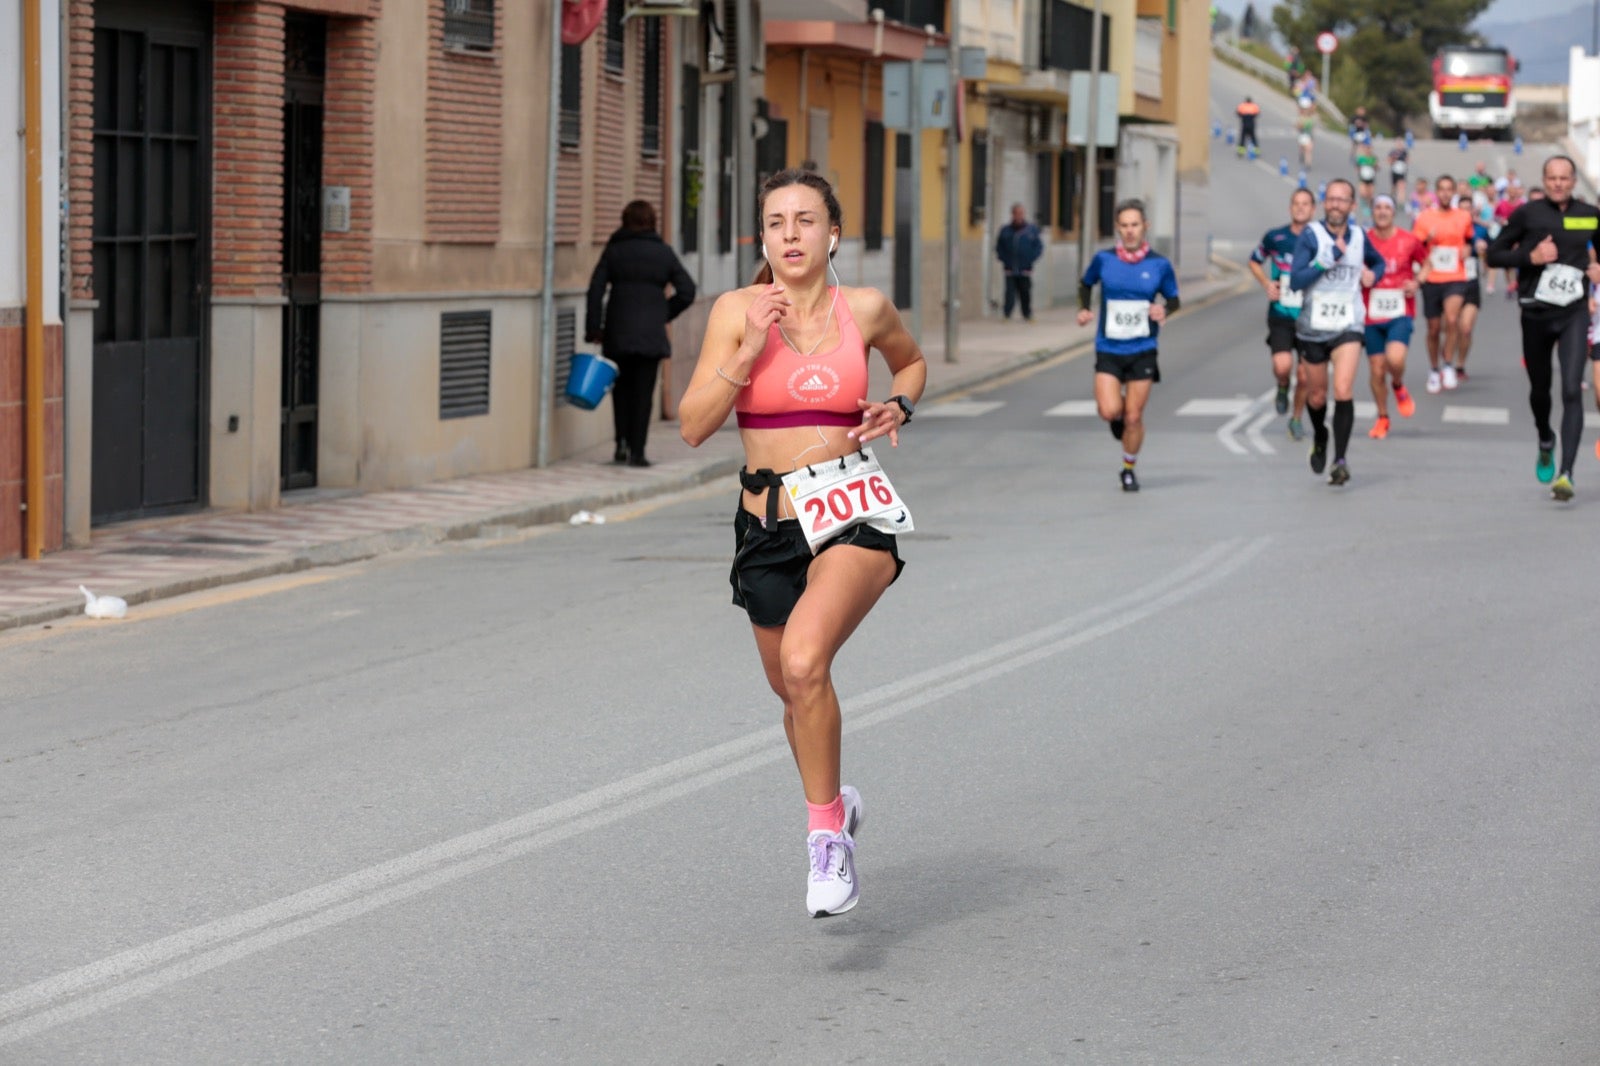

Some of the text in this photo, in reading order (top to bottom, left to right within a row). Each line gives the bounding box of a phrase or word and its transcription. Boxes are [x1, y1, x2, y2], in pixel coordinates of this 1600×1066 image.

[1548, 276, 1576, 294] 645
[1321, 302, 1346, 317] 274
[1115, 312, 1142, 326] 695
[804, 475, 893, 533] 2076
